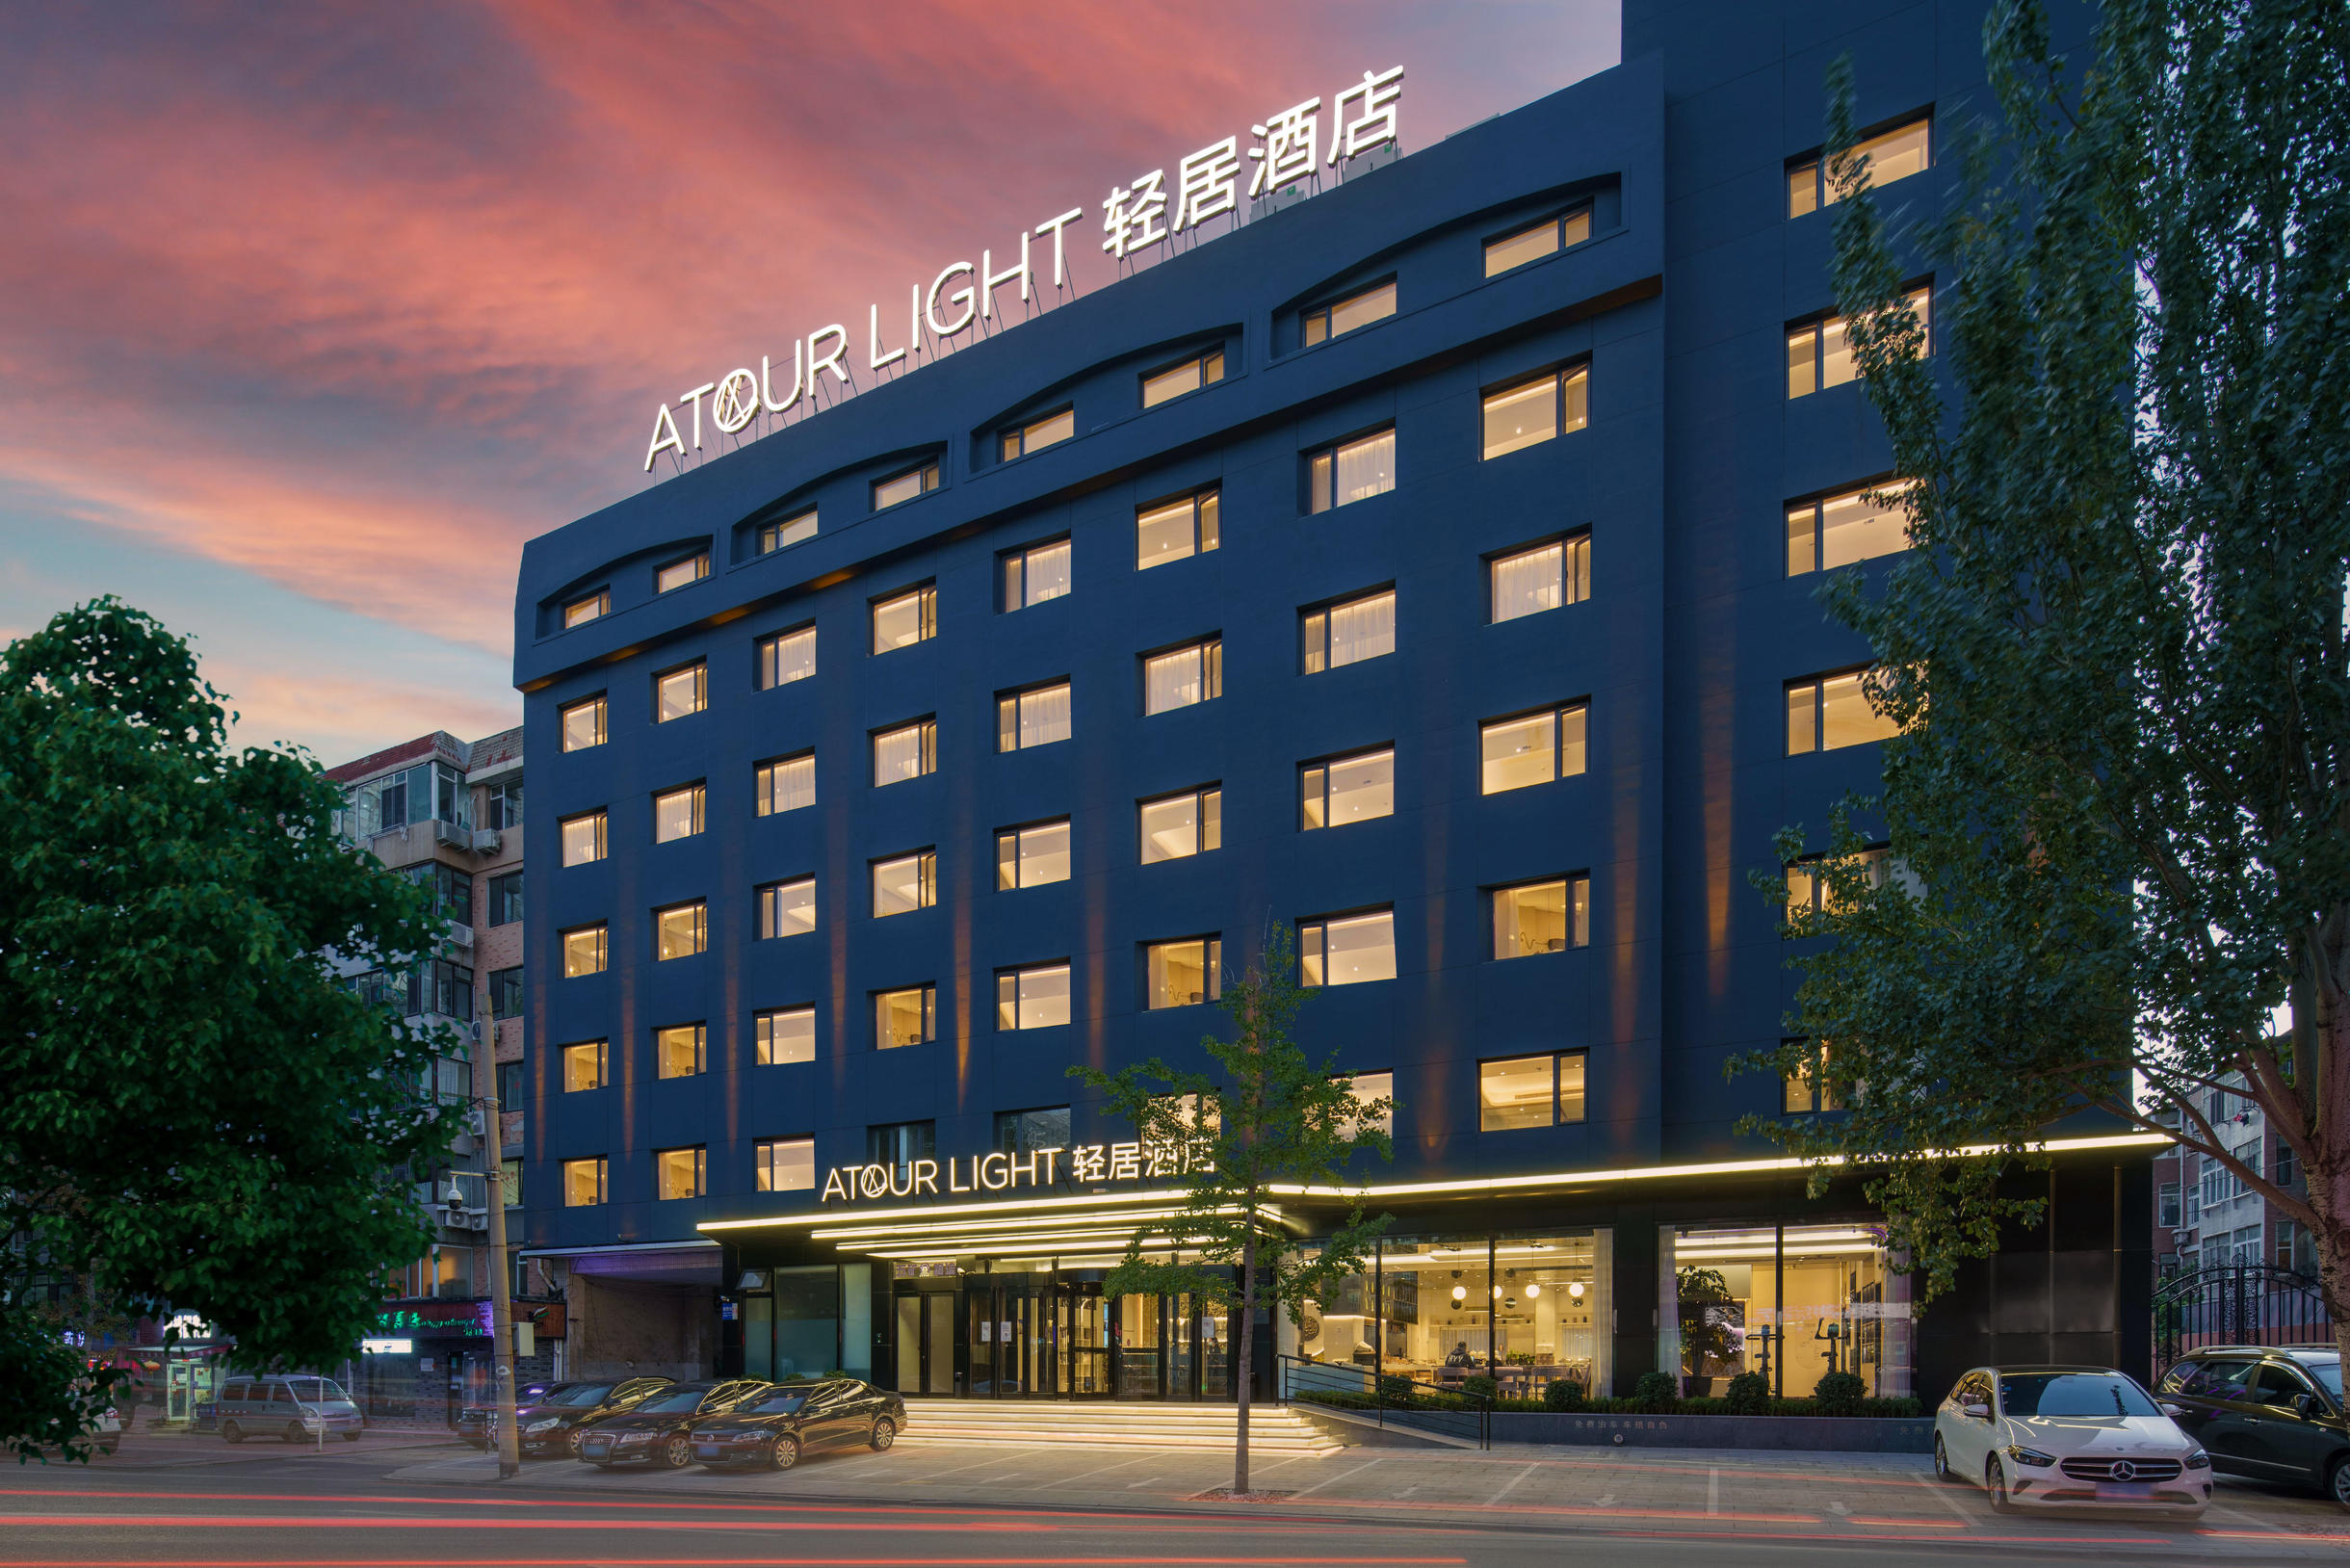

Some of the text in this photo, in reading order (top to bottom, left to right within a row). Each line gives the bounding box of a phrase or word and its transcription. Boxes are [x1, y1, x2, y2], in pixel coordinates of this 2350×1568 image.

[645, 65, 1404, 472] ATOUR LIGHT 轻居酒店
[822, 1161, 939, 1202] ATOUR
[950, 1149, 1062, 1191] LIGHT
